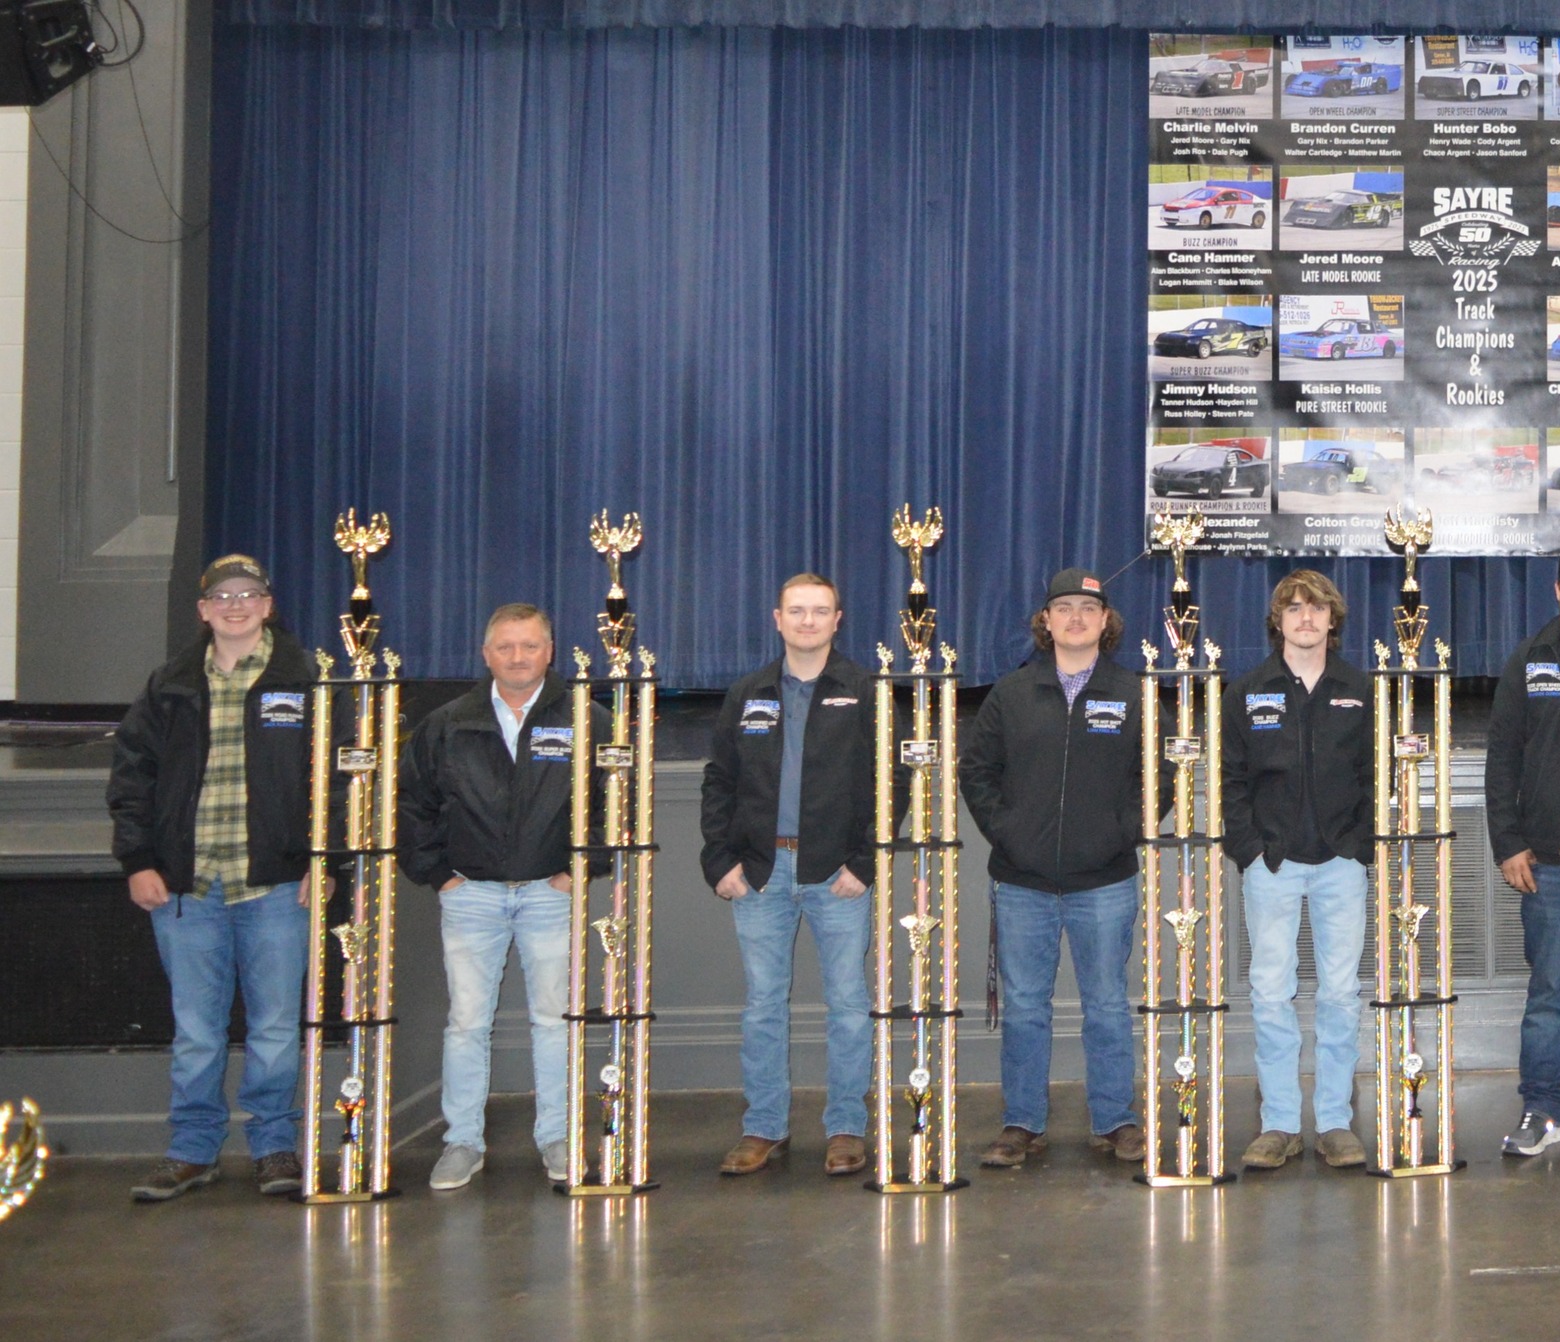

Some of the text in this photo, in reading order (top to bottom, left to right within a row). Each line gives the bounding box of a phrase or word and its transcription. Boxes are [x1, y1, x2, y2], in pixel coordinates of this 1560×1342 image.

[1175, 106, 1246, 117] LATE MODEL CHAMPION
[1308, 106, 1377, 116] OPEN WHEEL CHAMPION
[1436, 106, 1508, 117] SUPER STREET CHAMPION
[1163, 121, 1259, 133] Charlie Melvin
[1290, 122, 1396, 134] Brandon Curren
[1433, 123, 1517, 134] Hunter Bobo
[1170, 136, 1191, 144] Jered
[1191, 136, 1215, 144] Moore
[1219, 137, 1238, 146] Gary
[1297, 137, 1389, 146] Gary Nix Brandon Parker
[1433, 187, 1514, 217] SAYRE
[1443, 212, 1503, 224] SPEEDWAY
[1458, 227, 1492, 243] 50
[1182, 237, 1238, 247] BUZZ CHAMPION
[1168, 252, 1256, 263] Cane Hamner
[1299, 253, 1384, 264] Jered Moore
[1447, 256, 1501, 270] Racing
[1301, 270, 1381, 283] LATE MODEL ROOKIE
[1452, 269, 1499, 292] 2025
[1158, 278, 1182, 288] Logan
[1182, 278, 1213, 286] Hammitt
[1238, 278, 1264, 286] Wilson
[1455, 297, 1495, 320] Track
[1435, 325, 1515, 355] Champions
[1170, 365, 1250, 376] SUPER BUZZ CHAMPION
[1469, 354, 1482, 376] &
[1161, 383, 1257, 397] Jimmy Hudson
[1301, 383, 1382, 395] Kaisie Hollis
[1446, 382, 1505, 406] Rookies
[1295, 400, 1387, 413] PURE STREET ROOKIE
[1164, 410, 1255, 419] Russ Holley Steven Pate
[1228, 466, 1237, 487] 4
[1199, 501, 1232, 512] CHAMPION
[1242, 502, 1268, 512] ROOKIE
[1204, 516, 1260, 528] lexander
[1304, 516, 1381, 530] Colton Gray
[1304, 533, 1381, 546] HOT SHOT ROOKIE
[1503, 532, 1535, 546] ROOKIE
[1246, 543, 1268, 551] Parks
